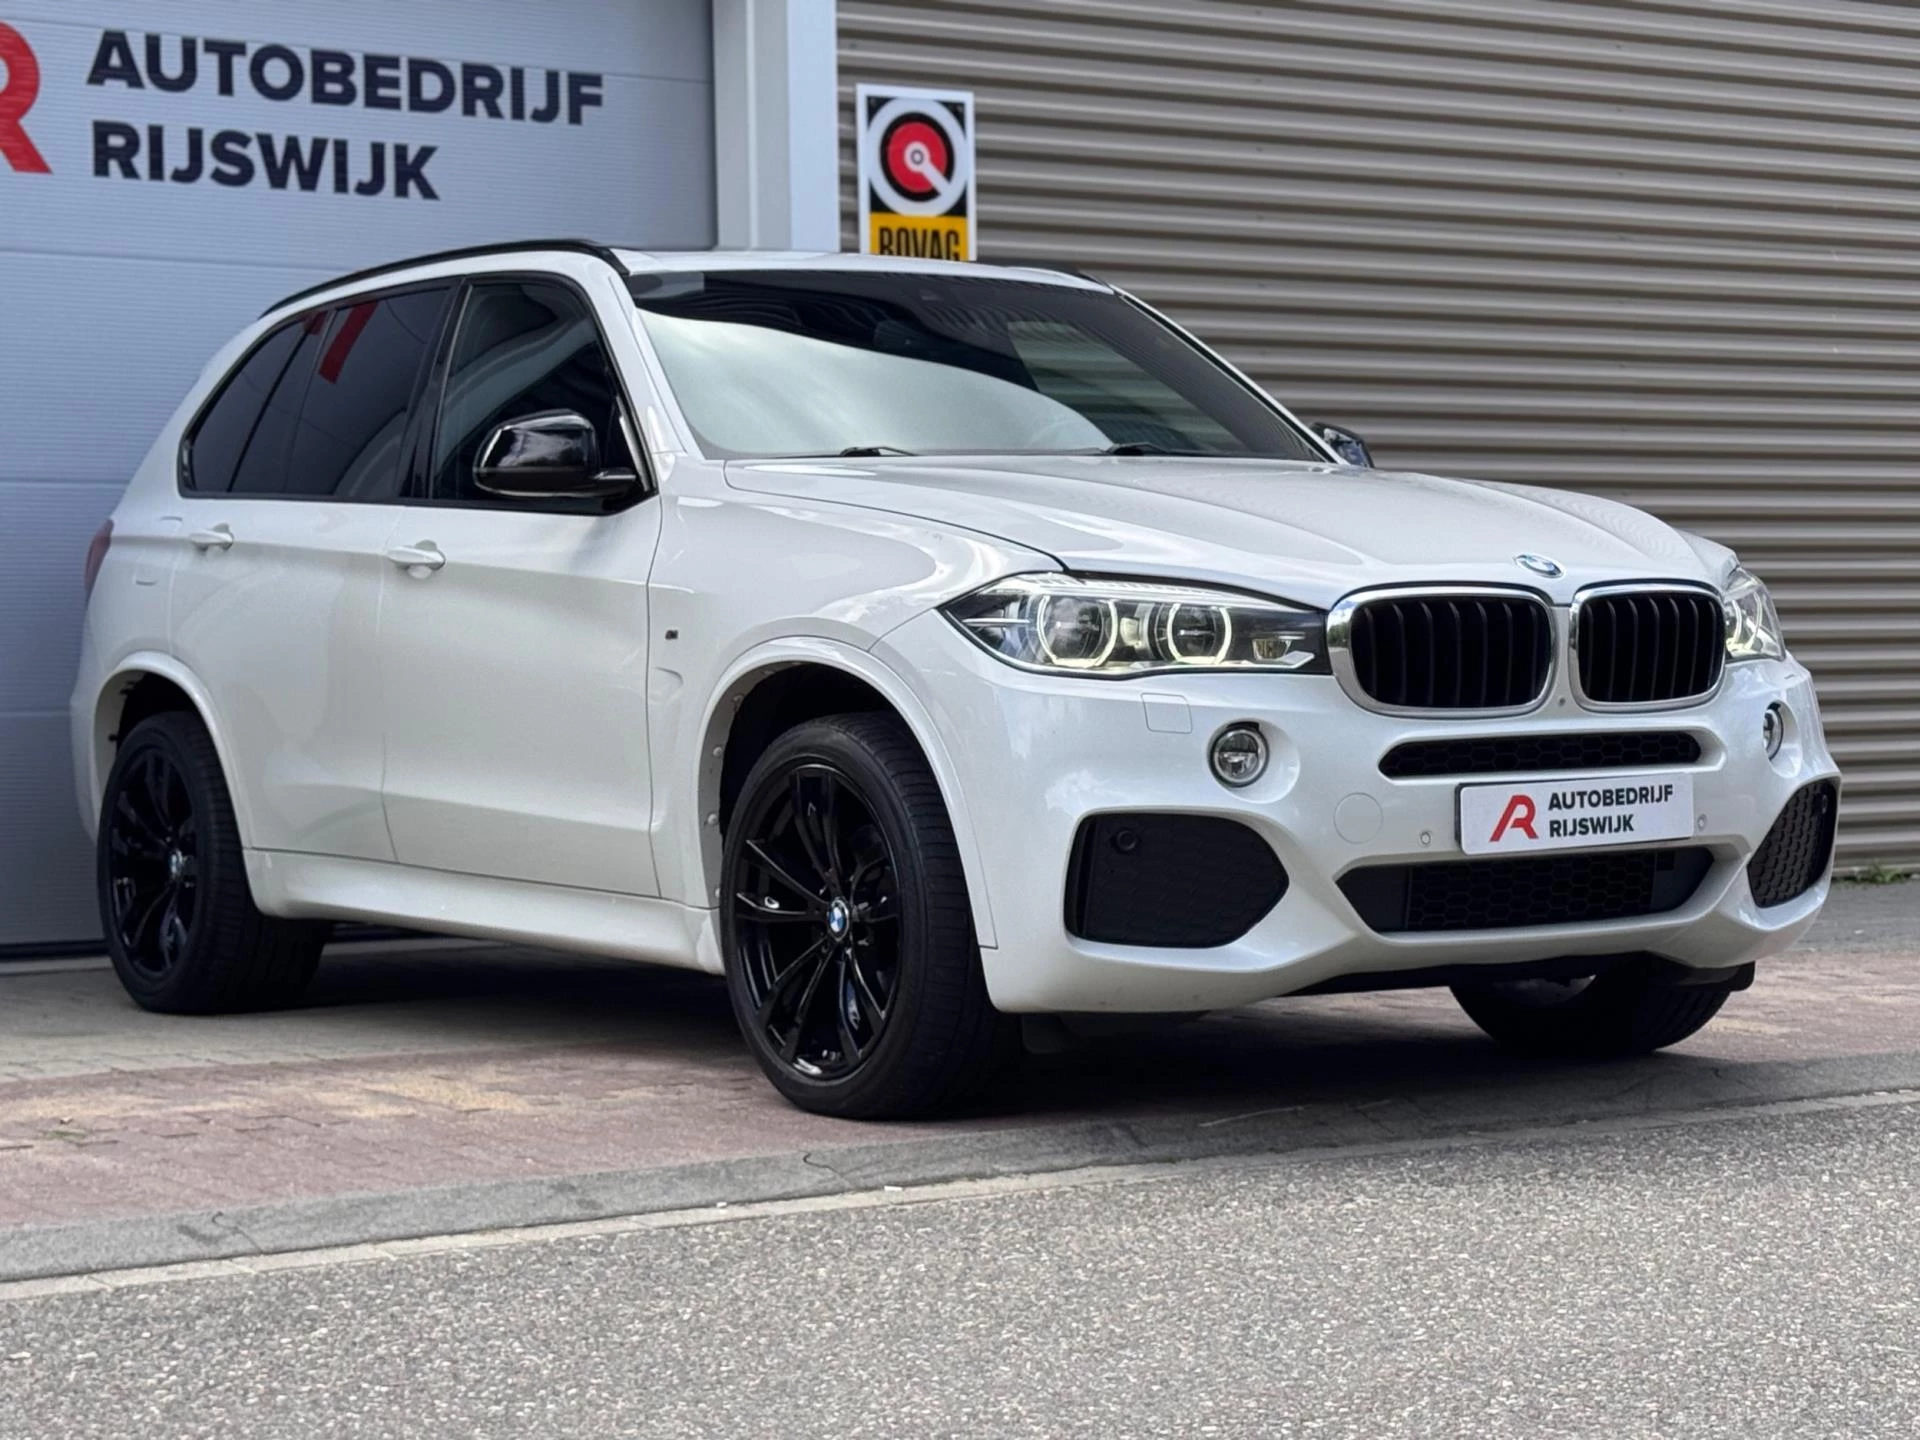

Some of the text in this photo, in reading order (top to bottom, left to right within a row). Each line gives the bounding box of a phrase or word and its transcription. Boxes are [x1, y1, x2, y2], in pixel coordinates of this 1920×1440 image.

[87, 29, 604, 125] AUTOBEDRIJF
[92, 120, 440, 200] RIJSWIJK
[879, 227, 961, 261] BOVAG
[1548, 784, 1673, 811] AUTOBEDRIJF
[1549, 815, 1634, 838] RIJSWIJK
